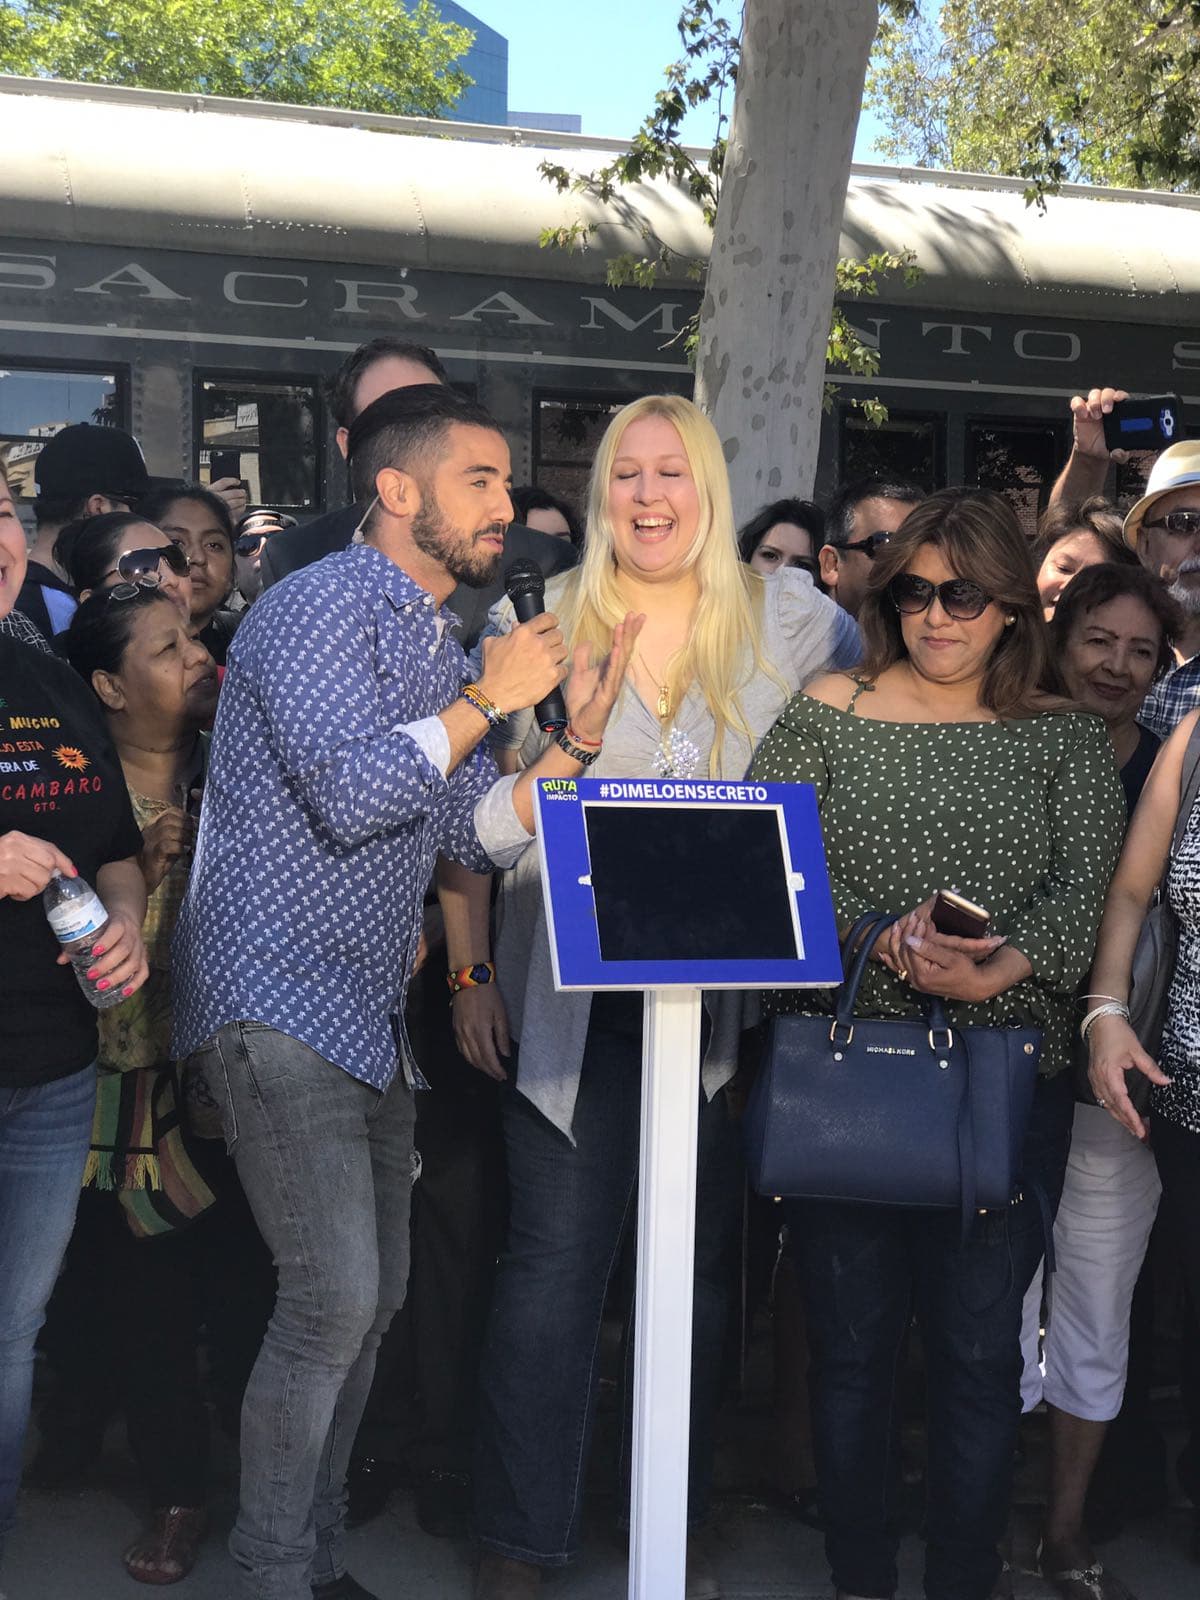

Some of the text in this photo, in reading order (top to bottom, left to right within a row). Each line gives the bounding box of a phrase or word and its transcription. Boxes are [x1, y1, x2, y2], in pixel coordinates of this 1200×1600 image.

[0, 252, 1081, 362] SACRAMNTO
[9, 717, 60, 729] MUCHO
[16, 740, 45, 753] ESTA
[22, 760, 40, 772] DE
[541, 779, 577, 793] RUTA
[599, 783, 768, 801] #DIMELOENSECRETO
[546, 793, 578, 801] IMPACTO
